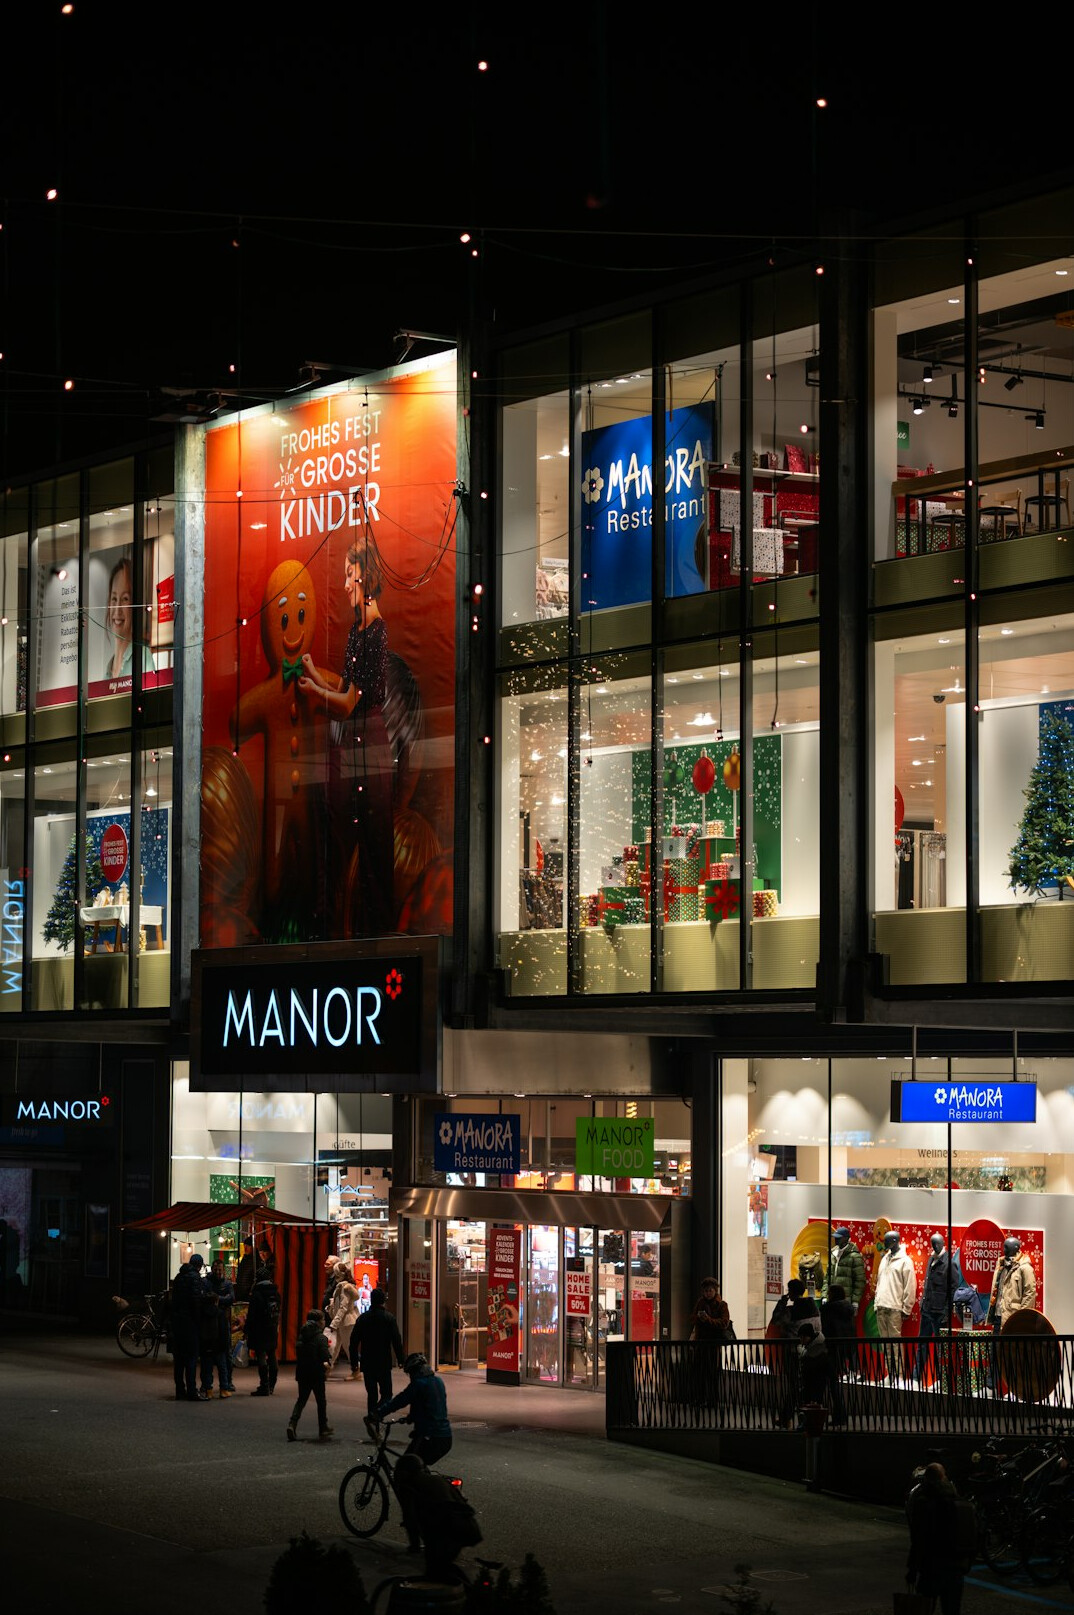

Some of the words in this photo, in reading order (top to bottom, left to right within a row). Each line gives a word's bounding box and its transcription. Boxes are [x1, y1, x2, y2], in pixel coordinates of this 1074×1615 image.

[281, 421, 340, 457] FROHES
[345, 411, 381, 441] FEST
[280, 473, 294, 486] FÜR
[301, 443, 381, 487] GROSSE
[280, 482, 380, 541] KINDER
[223, 987, 382, 1047] MANOR
[949, 1086, 1003, 1109] MANORA
[17, 1101, 100, 1119] MANOR
[949, 1109, 1003, 1120] Restaurant
[454, 1118, 513, 1152] MANORA
[586, 1126, 643, 1146] MANOR
[454, 1151, 513, 1170] Restaurant
[602, 1148, 644, 1169] FOOD
[918, 1149, 958, 1158] Wellnes
[966, 1240, 988, 1248] FROHES
[567, 1274, 590, 1284] HOME
[568, 1284, 590, 1294] SALE
[571, 1300, 586, 1310] 50%
